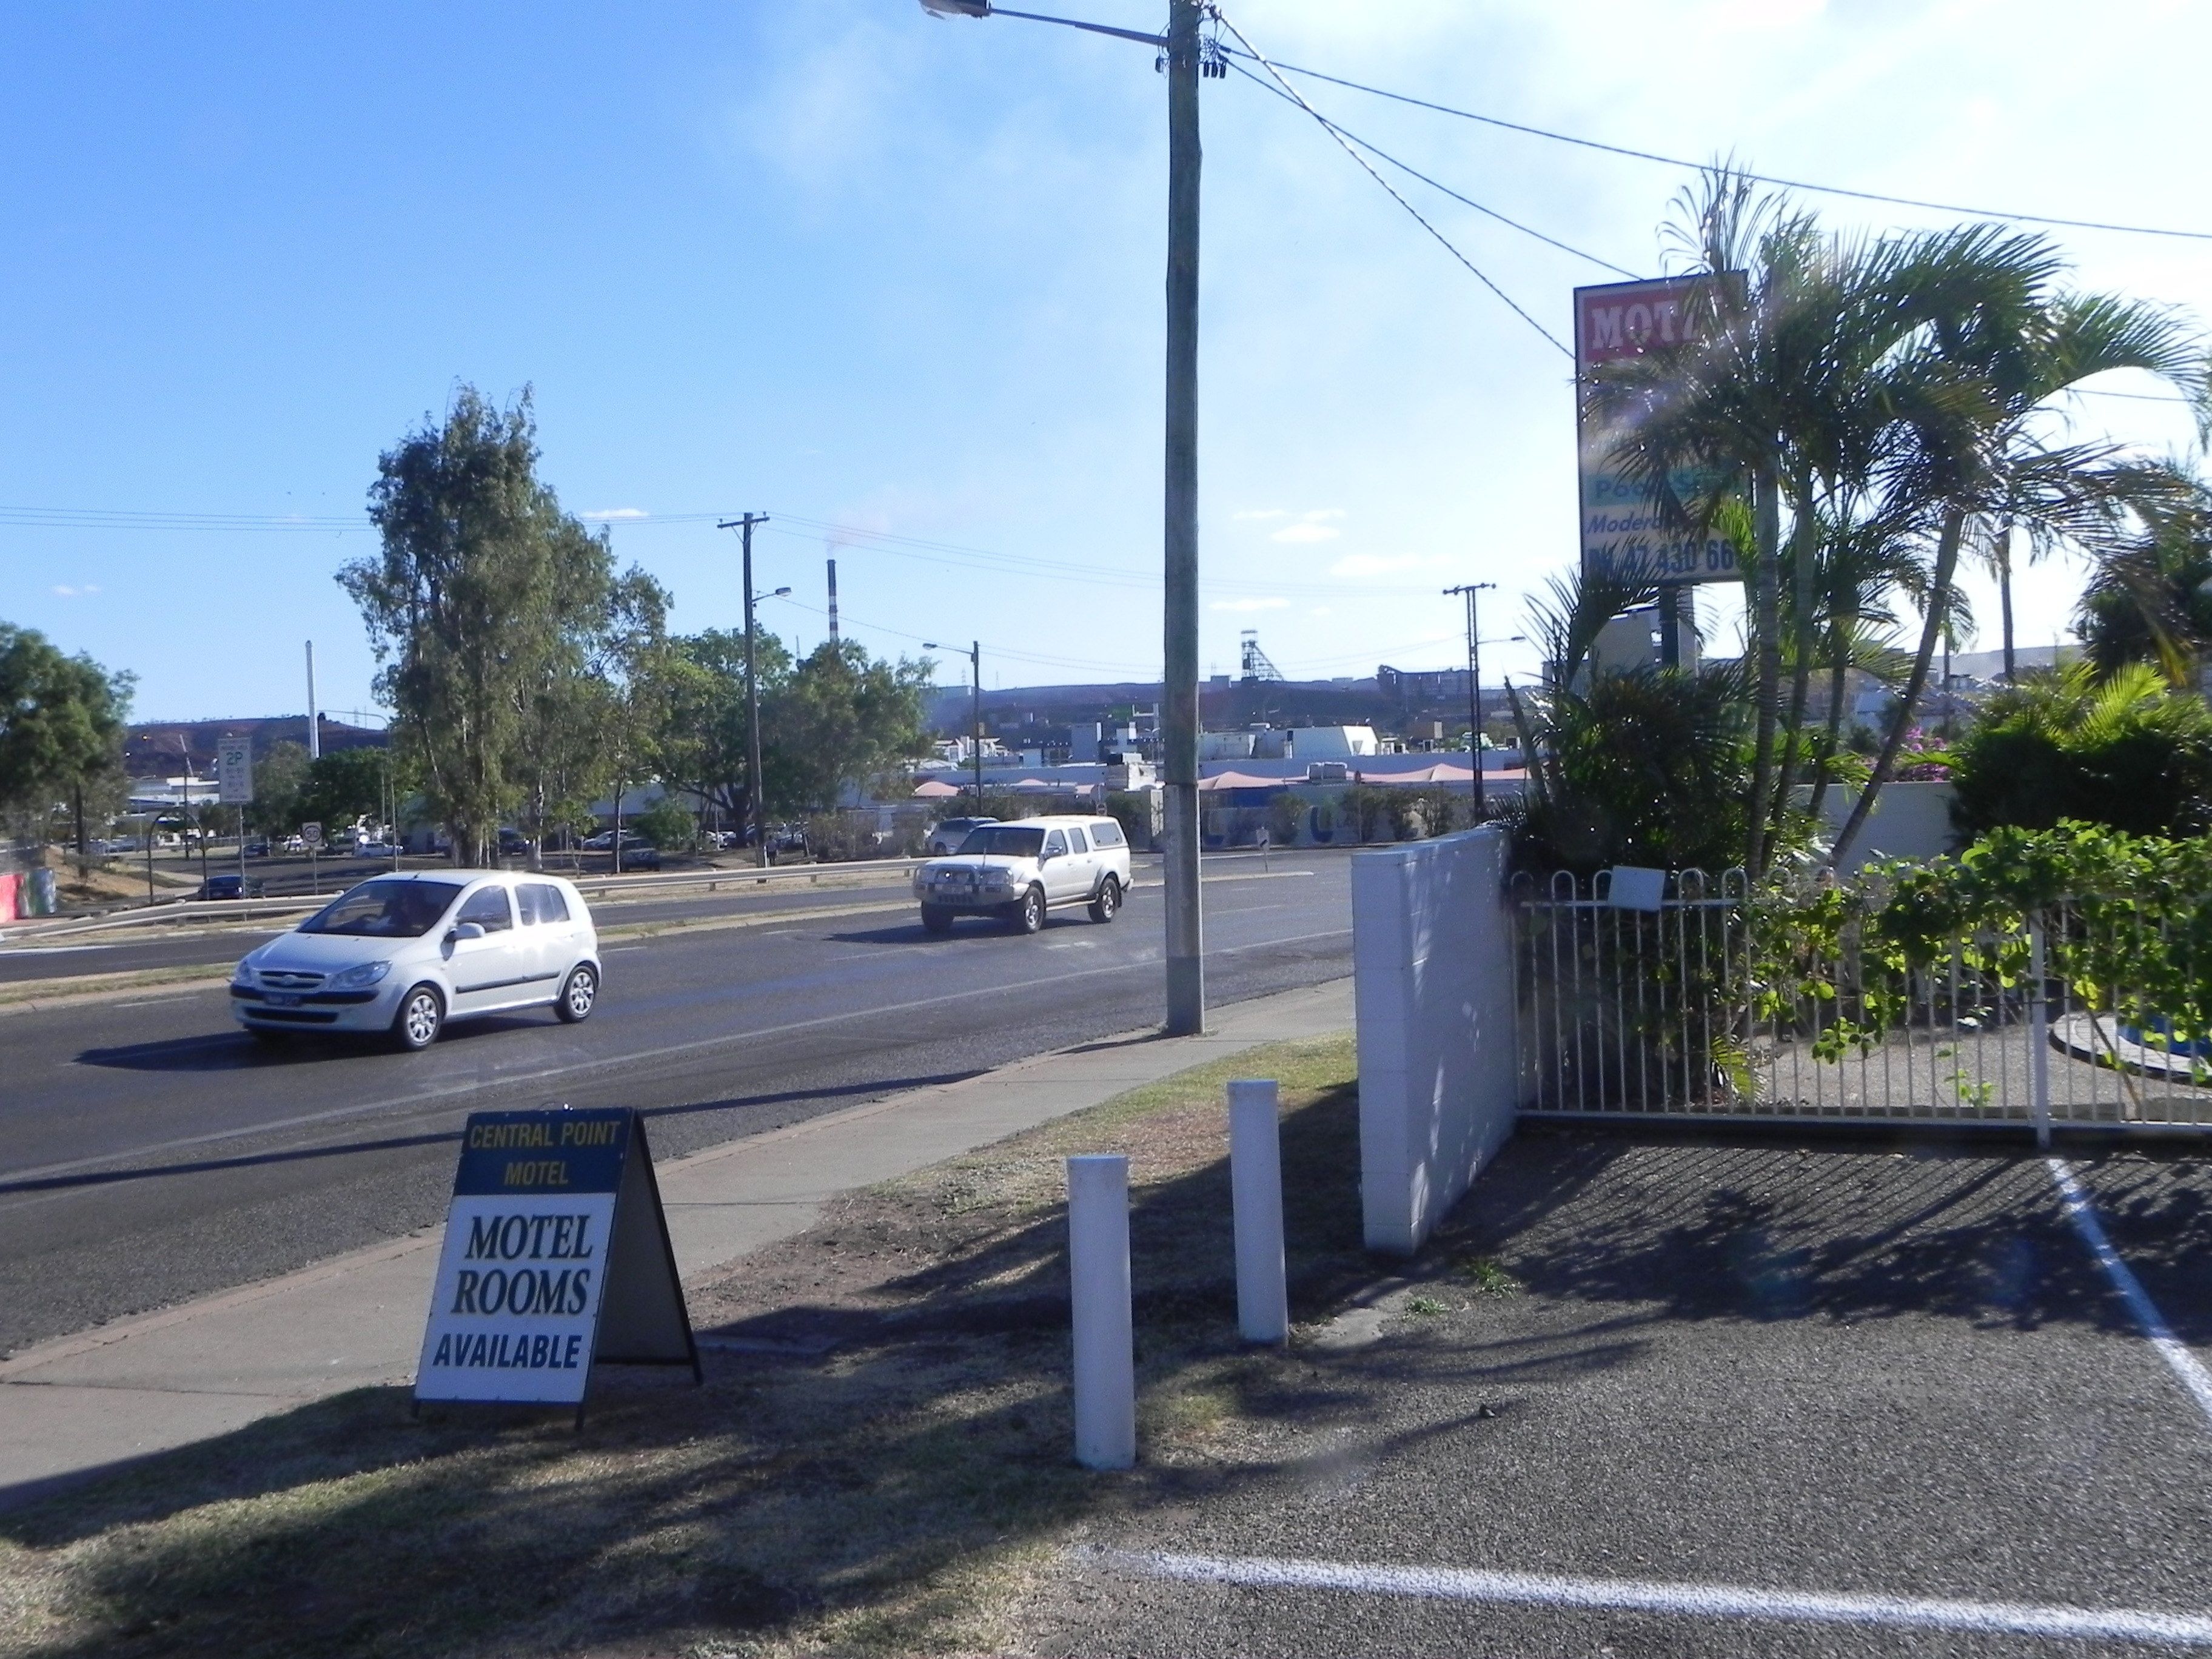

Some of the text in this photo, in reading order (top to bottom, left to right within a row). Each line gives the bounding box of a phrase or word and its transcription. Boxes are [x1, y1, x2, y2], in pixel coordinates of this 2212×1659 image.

[226, 751, 243, 765] 2P
[469, 1121, 621, 1149] CENTRAL POINT
[504, 1161, 569, 1186] MOTEL
[464, 1215, 594, 1260] MOTEL
[451, 1269, 591, 1316] ROOMS
[432, 1333, 583, 1369] AVAILABLE
